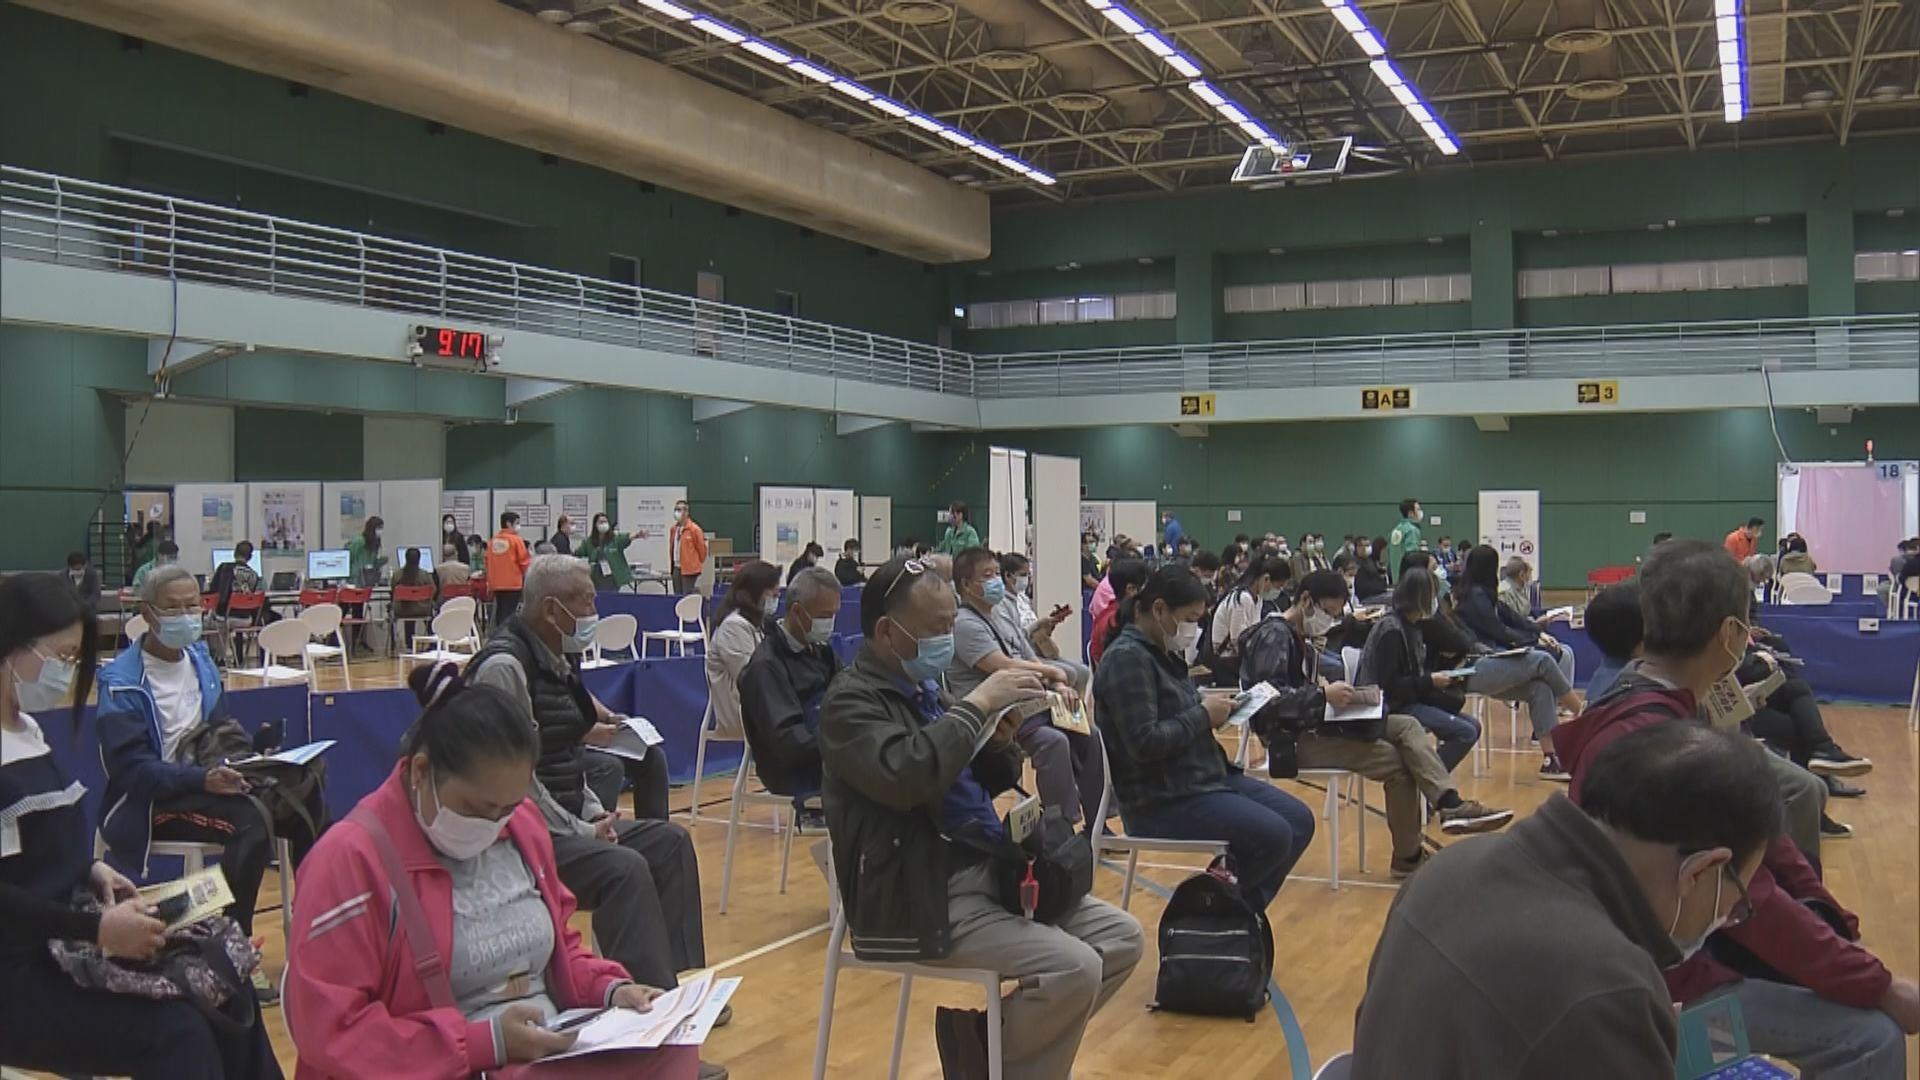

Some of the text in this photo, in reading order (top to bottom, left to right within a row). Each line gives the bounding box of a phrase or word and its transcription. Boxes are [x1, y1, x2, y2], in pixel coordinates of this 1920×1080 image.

[1380, 392, 1391, 406] A
[1604, 386, 1613, 399] 3
[1880, 464, 1899, 478] 18
